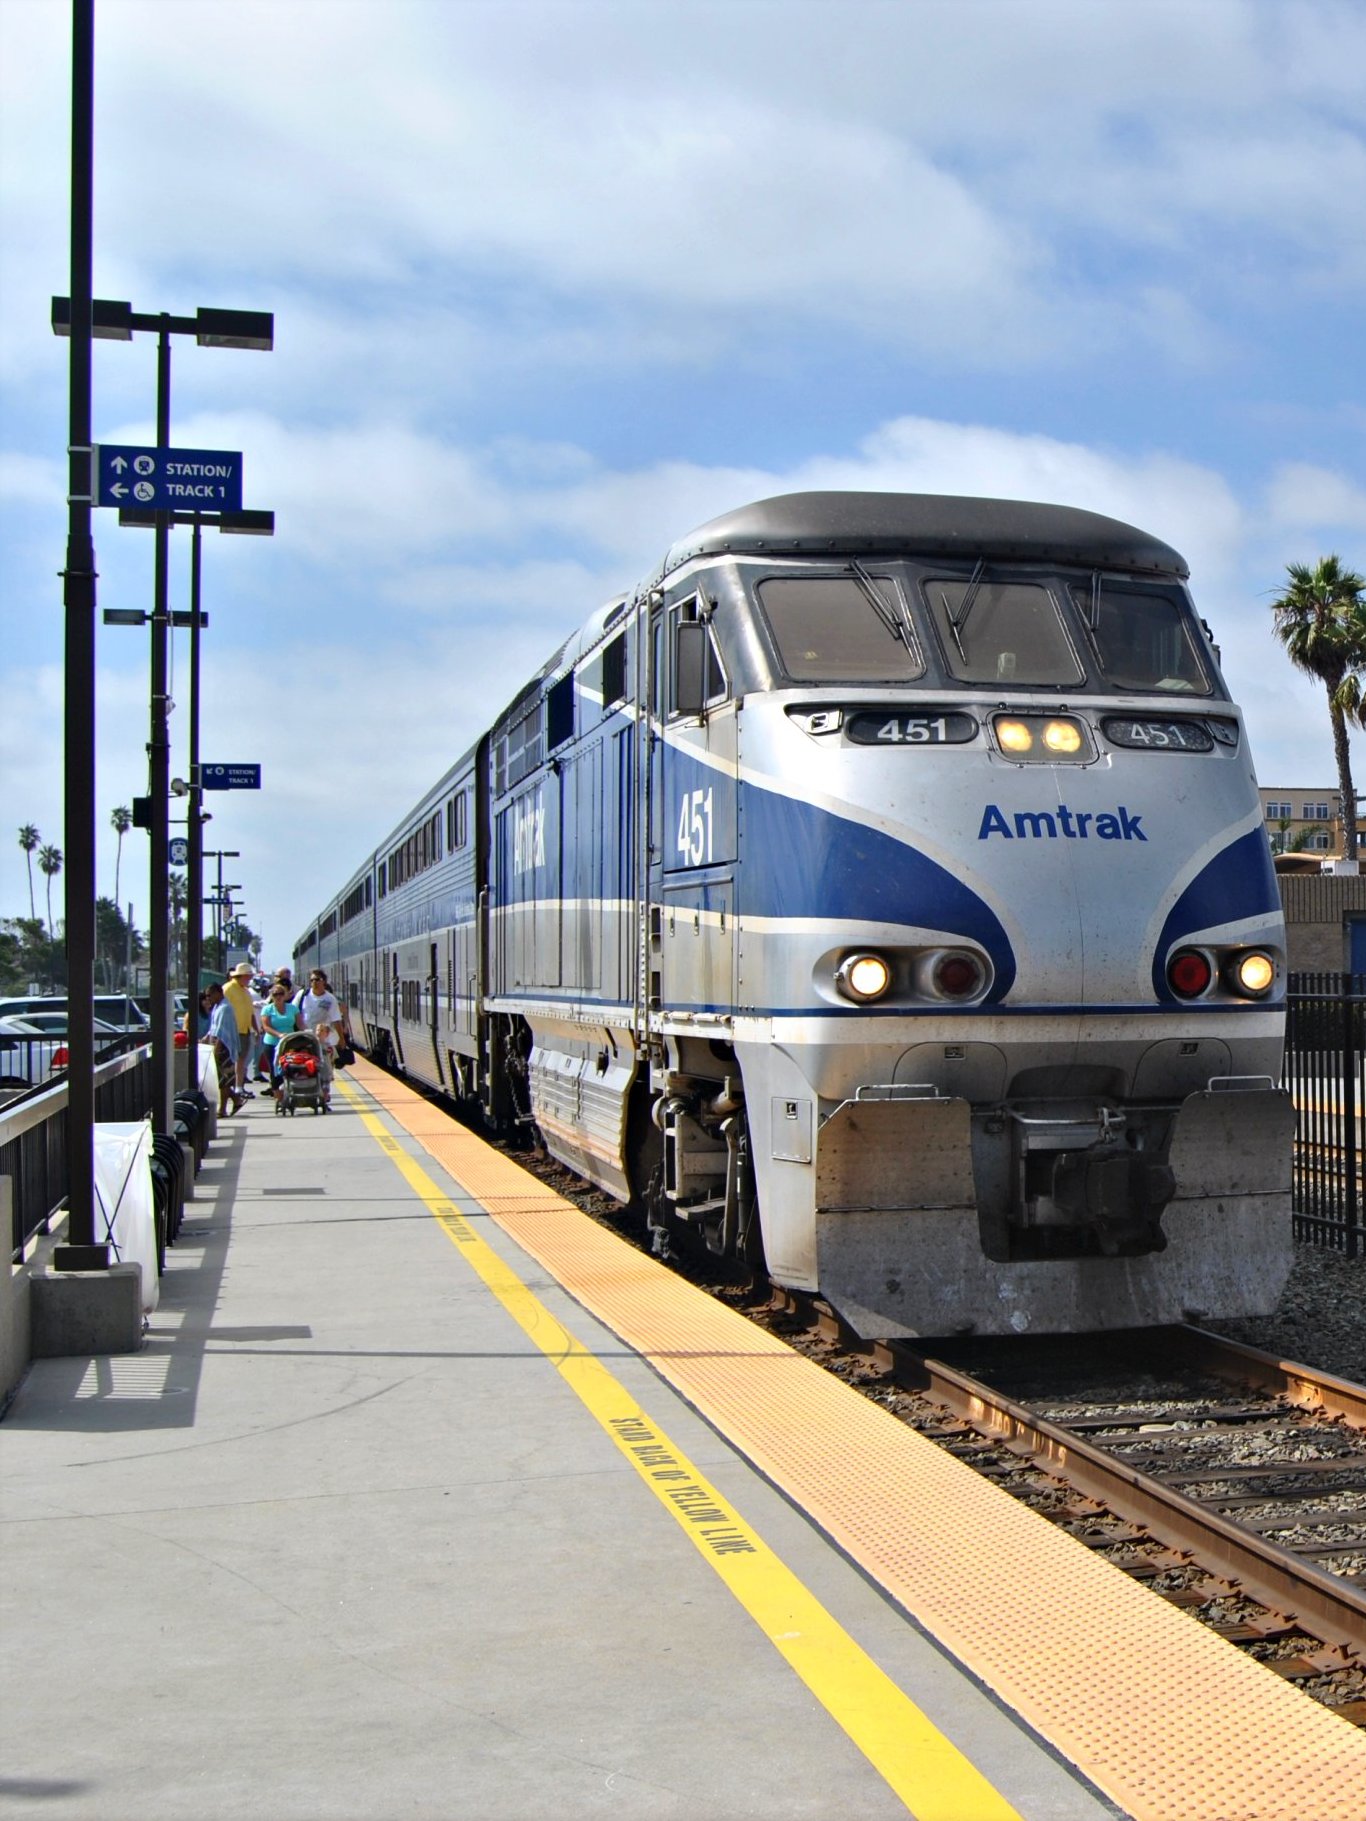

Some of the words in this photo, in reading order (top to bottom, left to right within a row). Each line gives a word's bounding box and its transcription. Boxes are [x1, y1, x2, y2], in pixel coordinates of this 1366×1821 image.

[166, 463, 232, 478] STATION/
[166, 484, 214, 497] TRACK
[219, 486, 225, 498] 1
[877, 719, 947, 742] 451
[1131, 724, 1186, 745] 451
[514, 790, 546, 877] Amtrak
[677, 787, 713, 867] 451
[978, 804, 1148, 841] Amtrak
[608, 1417, 656, 1442] STAND
[630, 1444, 678, 1467] BACK
[651, 1469, 691, 1481] OF
[664, 1485, 730, 1523] YELLOW
[699, 1527, 758, 1556] LINE
